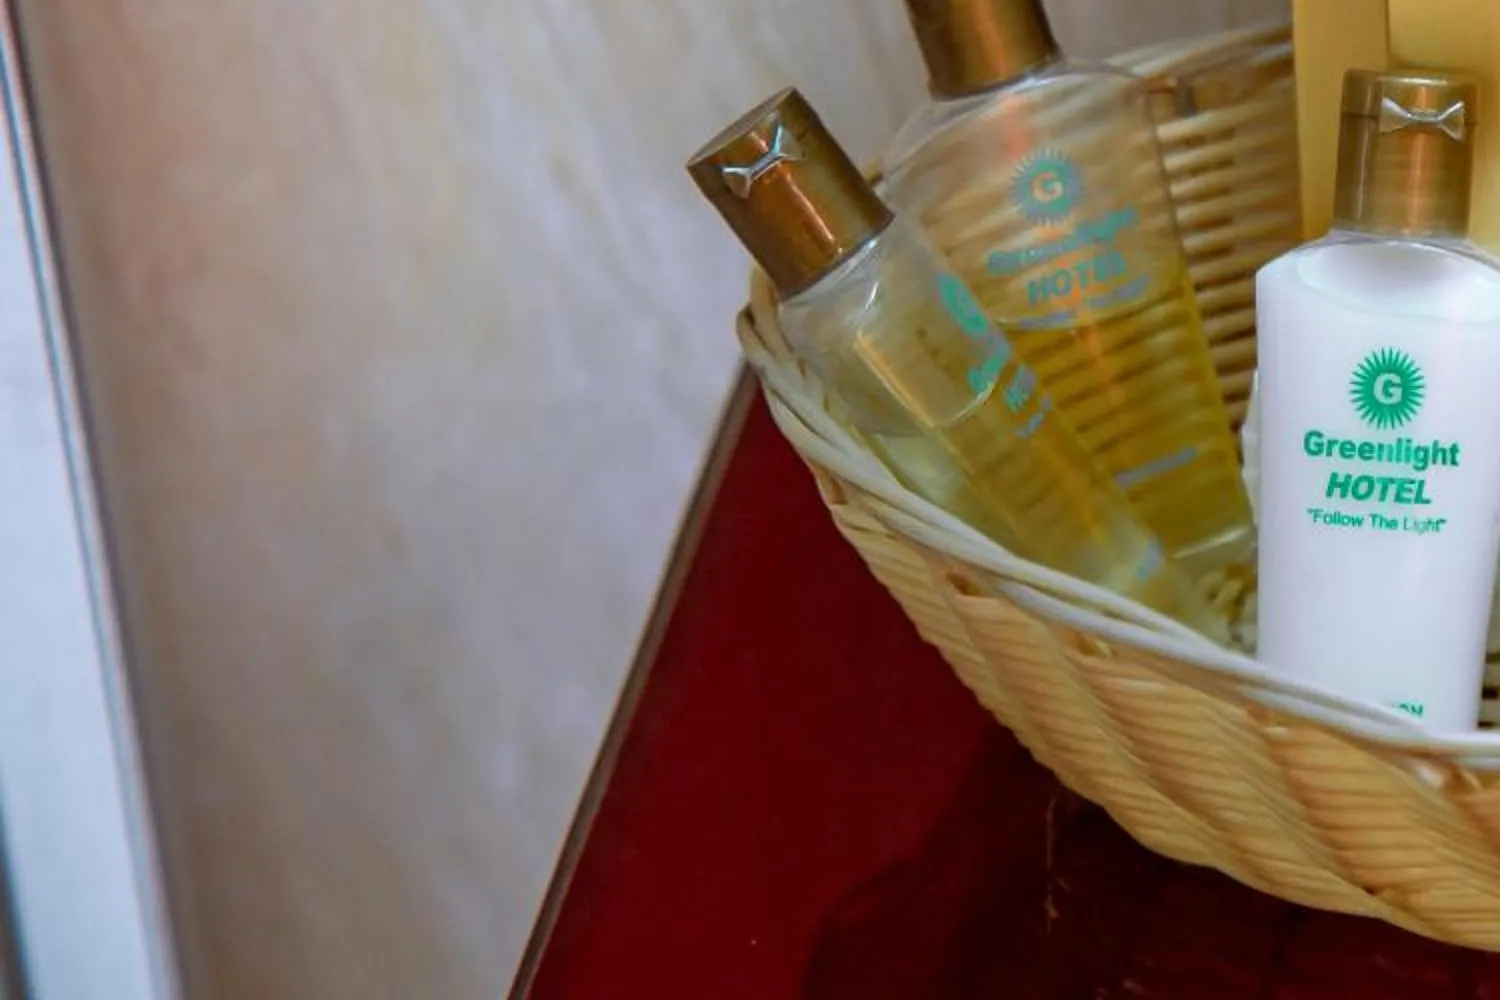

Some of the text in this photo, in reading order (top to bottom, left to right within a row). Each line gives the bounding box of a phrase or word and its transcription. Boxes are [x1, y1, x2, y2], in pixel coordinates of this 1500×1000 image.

[1372, 371, 1404, 406] G
[1303, 430, 1461, 472] Greenlight
[1325, 471, 1433, 505] HOTEL
[1369, 512, 1399, 531] The
